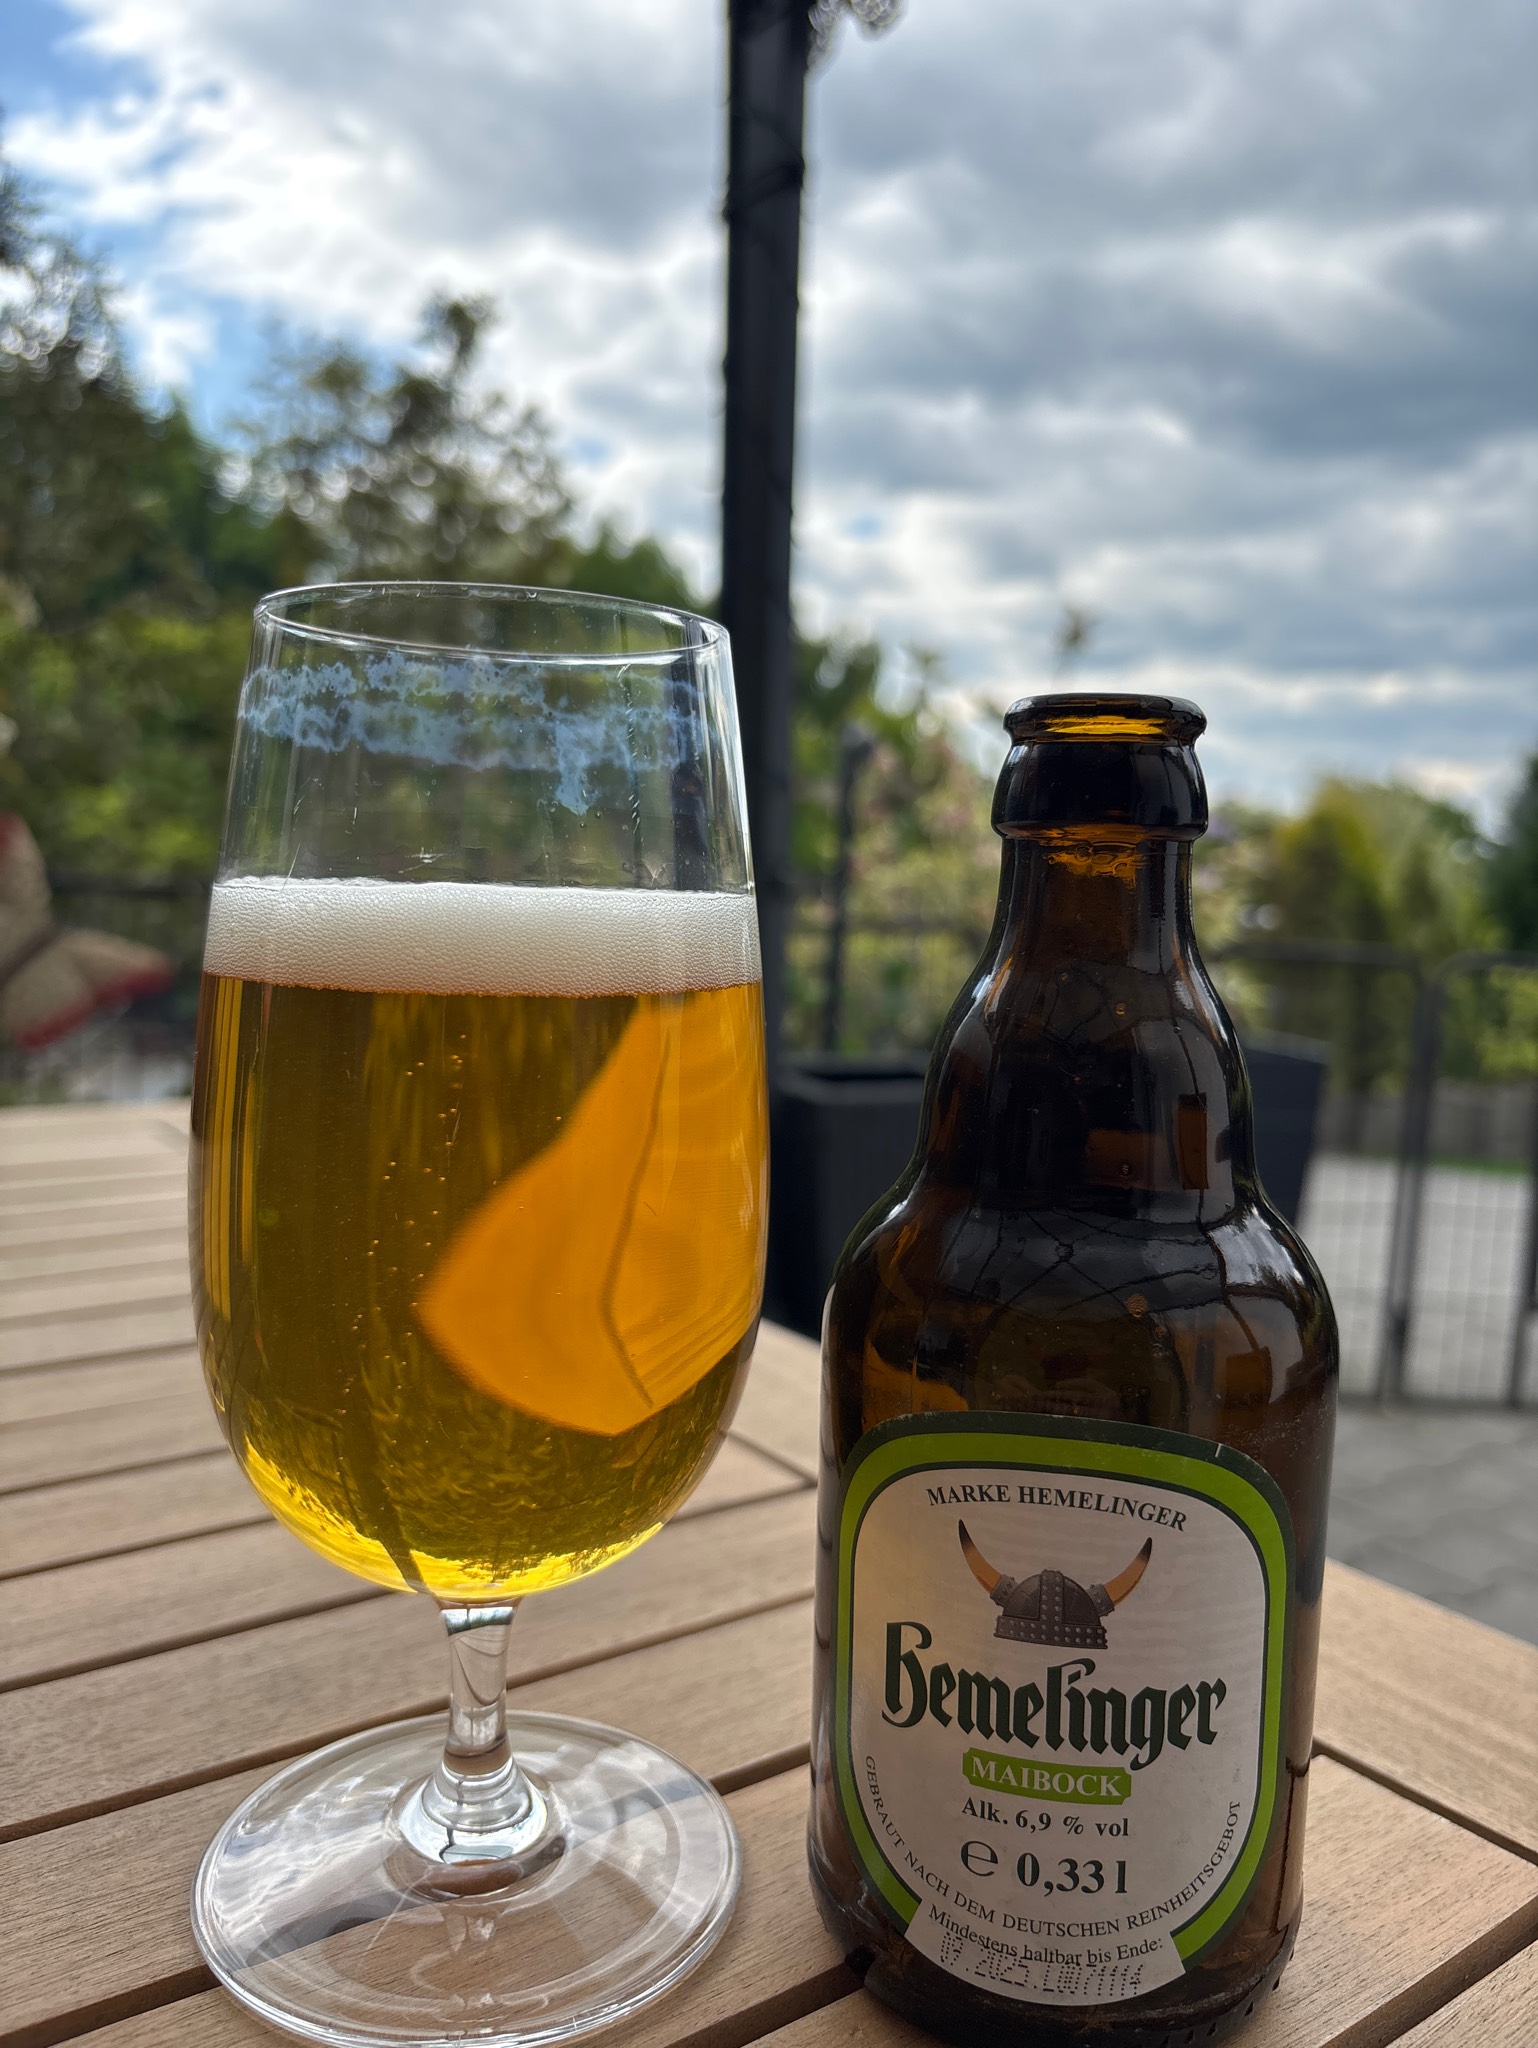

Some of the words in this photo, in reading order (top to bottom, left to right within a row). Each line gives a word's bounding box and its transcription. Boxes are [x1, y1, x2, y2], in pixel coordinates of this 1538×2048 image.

[926, 1484, 1011, 1506] MARKE
[1017, 1485, 1187, 1532] HEMELINGER
[881, 1621, 1228, 1771] Hemelinger
[971, 1756, 1122, 1797] MAIBOCK
[961, 1797, 1008, 1825] Alk.
[1015, 1809, 1052, 1833] 6,9
[1063, 1815, 1084, 1835] %
[1095, 1818, 1129, 1837] vol
[865, 1755, 904, 1848] GEBRAUT
[904, 1850, 950, 1898] NACH
[953, 1891, 996, 1923] DEM
[1002, 1913, 1120, 1938] DEUTSCHEN
[1127, 1801, 1241, 1930] REINHEITSGEBOT
[928, 1904, 1018, 1957] Mindestens
[1022, 1944, 1082, 1966] haltbar
[1086, 1949, 1112, 1965] bis
[1117, 1937, 1163, 1961] Ende:
